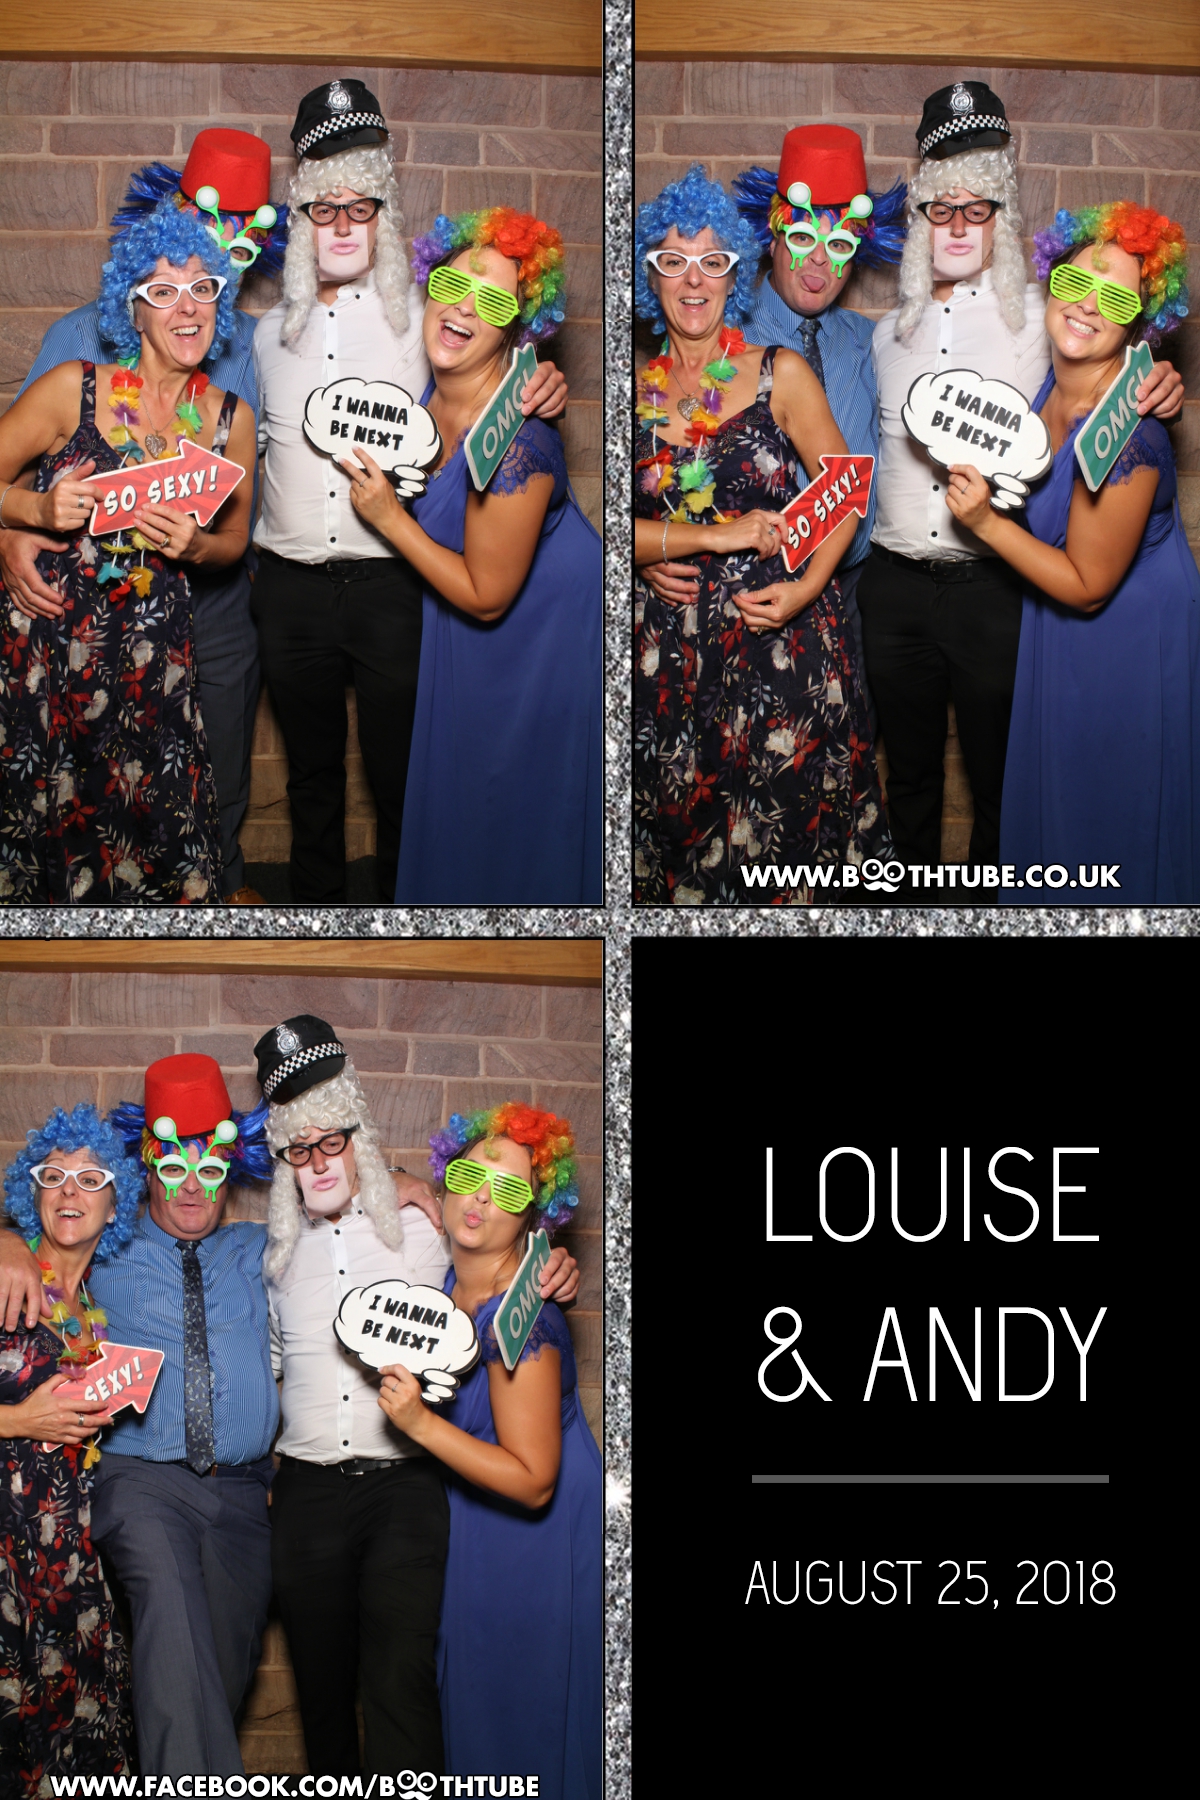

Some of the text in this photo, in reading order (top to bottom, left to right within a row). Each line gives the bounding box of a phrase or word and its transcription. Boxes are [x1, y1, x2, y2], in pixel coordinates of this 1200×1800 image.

[332, 395, 408, 426] I WANNA
[939, 384, 1022, 433] I WANNA
[330, 420, 404, 451] BE NEXT
[931, 410, 1012, 457] BE NEXT
[103, 465, 218, 516] SO SEXY!
[787, 463, 861, 550] SO SEXY!
[368, 1294, 448, 1330] I WANNA
[361, 1319, 440, 1354] BE NEXT
[84, 1356, 144, 1402] SEXY!
